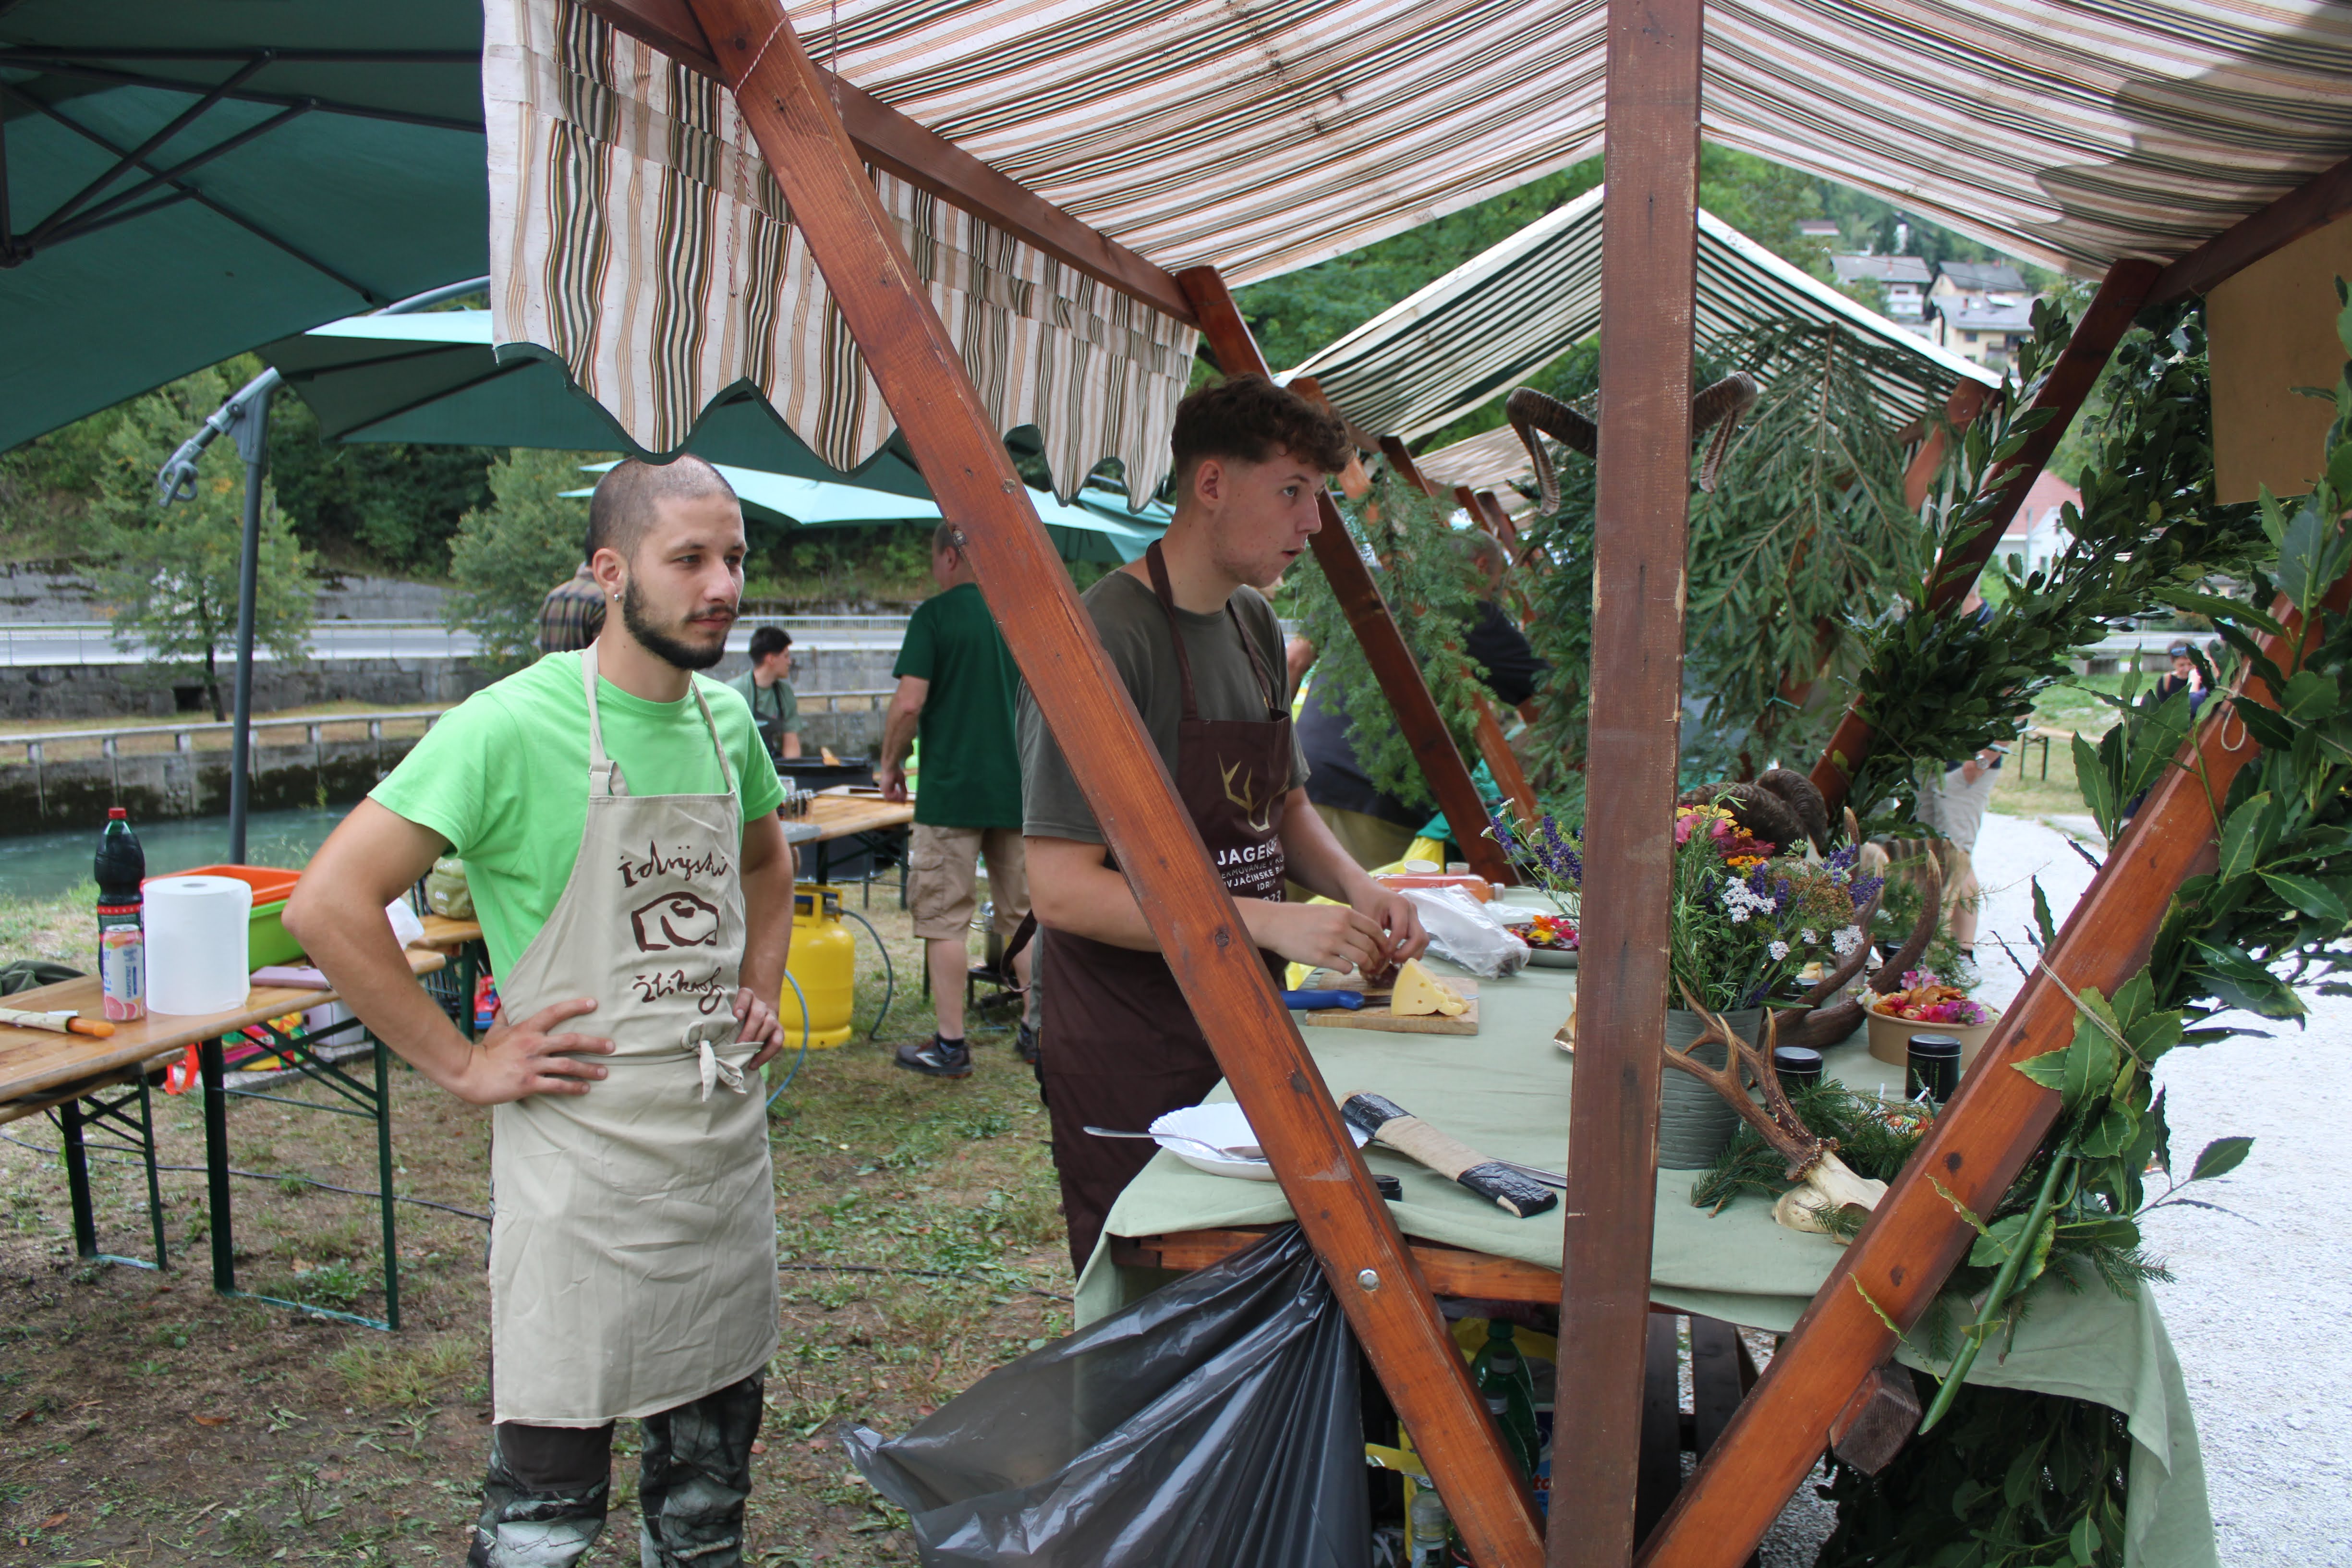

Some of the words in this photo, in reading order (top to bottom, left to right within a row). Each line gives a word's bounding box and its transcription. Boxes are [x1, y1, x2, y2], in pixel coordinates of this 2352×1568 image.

[1222, 862, 1267, 879] EKMOVANJE
[1275, 853, 1285, 864] KU
[1224, 869, 1274, 888] VJAČINSKE
